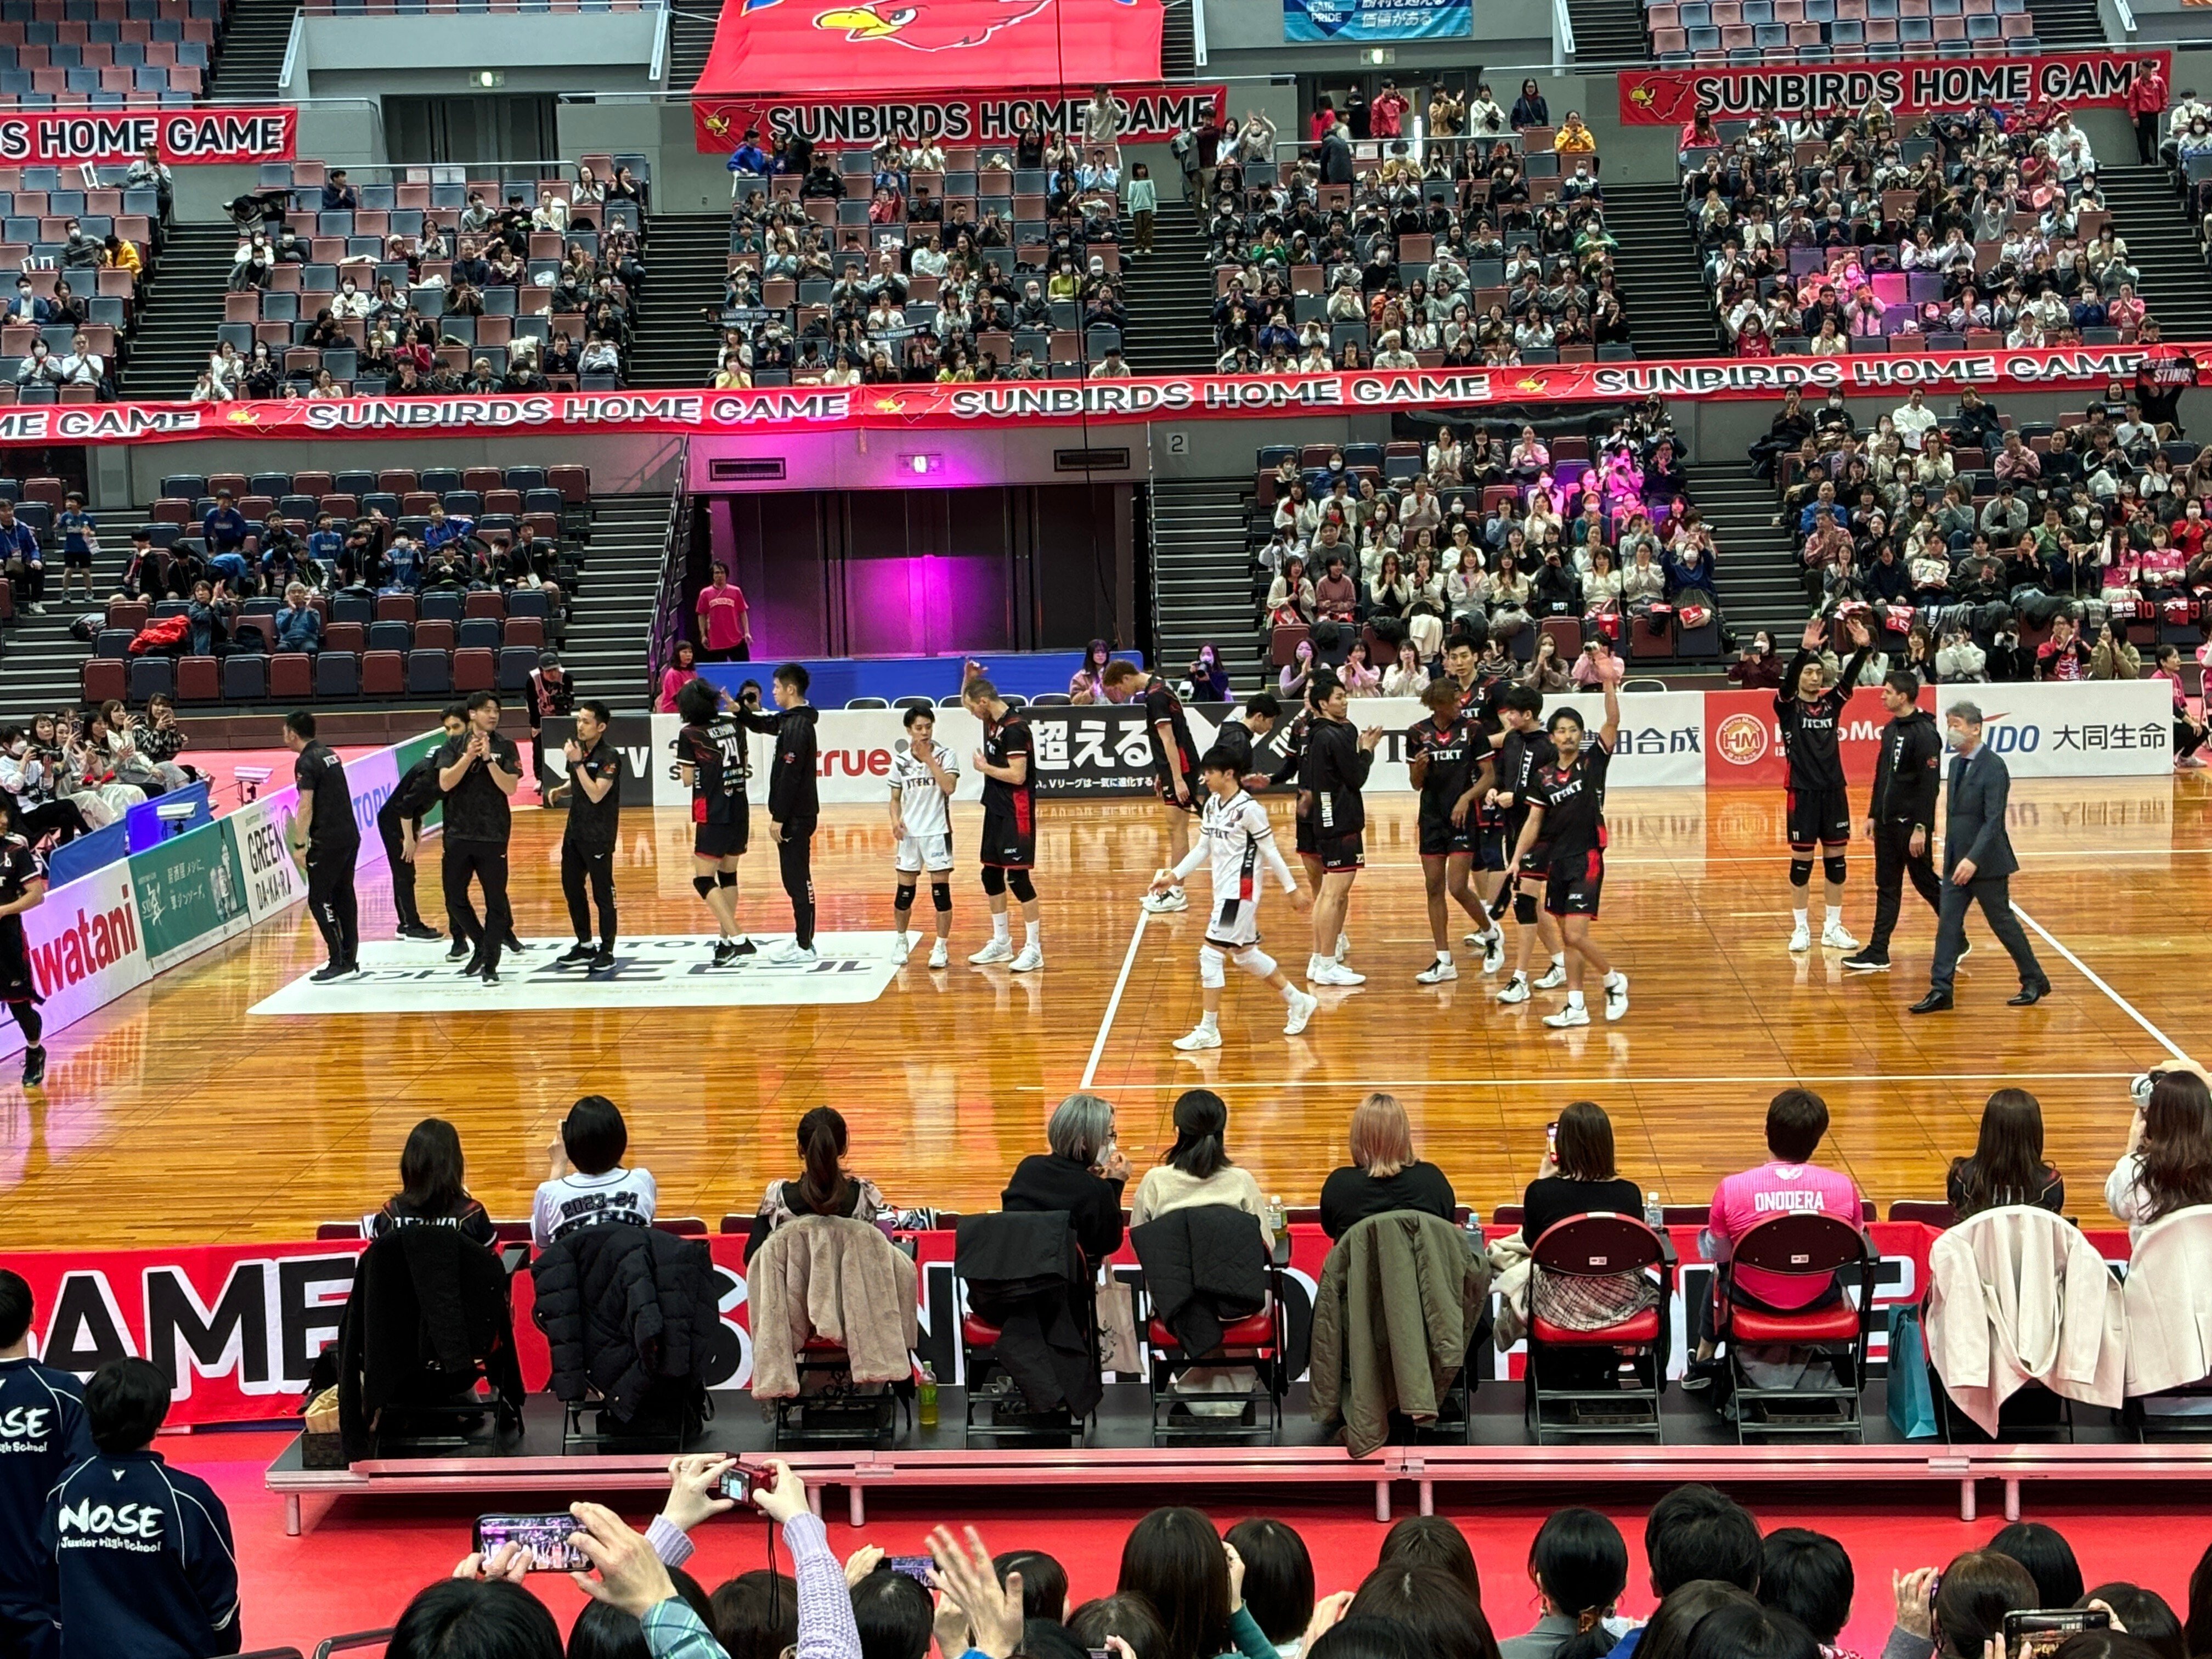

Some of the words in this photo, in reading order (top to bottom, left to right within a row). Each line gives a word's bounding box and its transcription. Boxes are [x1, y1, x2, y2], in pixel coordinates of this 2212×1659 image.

[1311, 12, 1342, 22] PRIDE
[1695, 69, 1904, 114] SUNBIRDS
[1912, 64, 2032, 107] HOME
[2039, 59, 2160, 102] GAM
[38, 116, 158, 157] HOME
[166, 114, 285, 155] GAME
[769, 101, 970, 143] SUNBIRDS
[981, 98, 1091, 138] HOME
[1593, 362, 1842, 394] SUNBIRDS
[1853, 358, 1996, 386] HOME
[2006, 354, 2148, 382] GAME
[306, 398, 552, 428] SUNBIRDS
[563, 397, 702, 425] HOME
[712, 394, 850, 422] GAME
[951, 382, 1195, 417] SUNBIRDS
[1204, 380, 1343, 408] HOME
[1352, 375, 1491, 404] GAME
[57, 408, 200, 437] GAME
[1171, 435, 1184, 452] 2
[2137, 601, 2155, 619] 10
[716, 736, 741, 768] 24
[1028, 719, 1154, 770] 超える
[1725, 731, 1760, 750] HM
[2052, 723, 2167, 751] 大同生命
[1430, 749, 1463, 761] TEKT
[1549, 779, 1583, 805] JTEKT
[247, 820, 286, 875] GREEN
[560, 1190, 639, 1220] 2023-24
[1754, 1190, 1825, 1212] ONODERA
[41, 1255, 359, 1389] AME
[58, 1497, 165, 1538] NOSE
[60, 1536, 98, 1549] Junior
[99, 1537, 124, 1549] High
[124, 1538, 161, 1553] School
